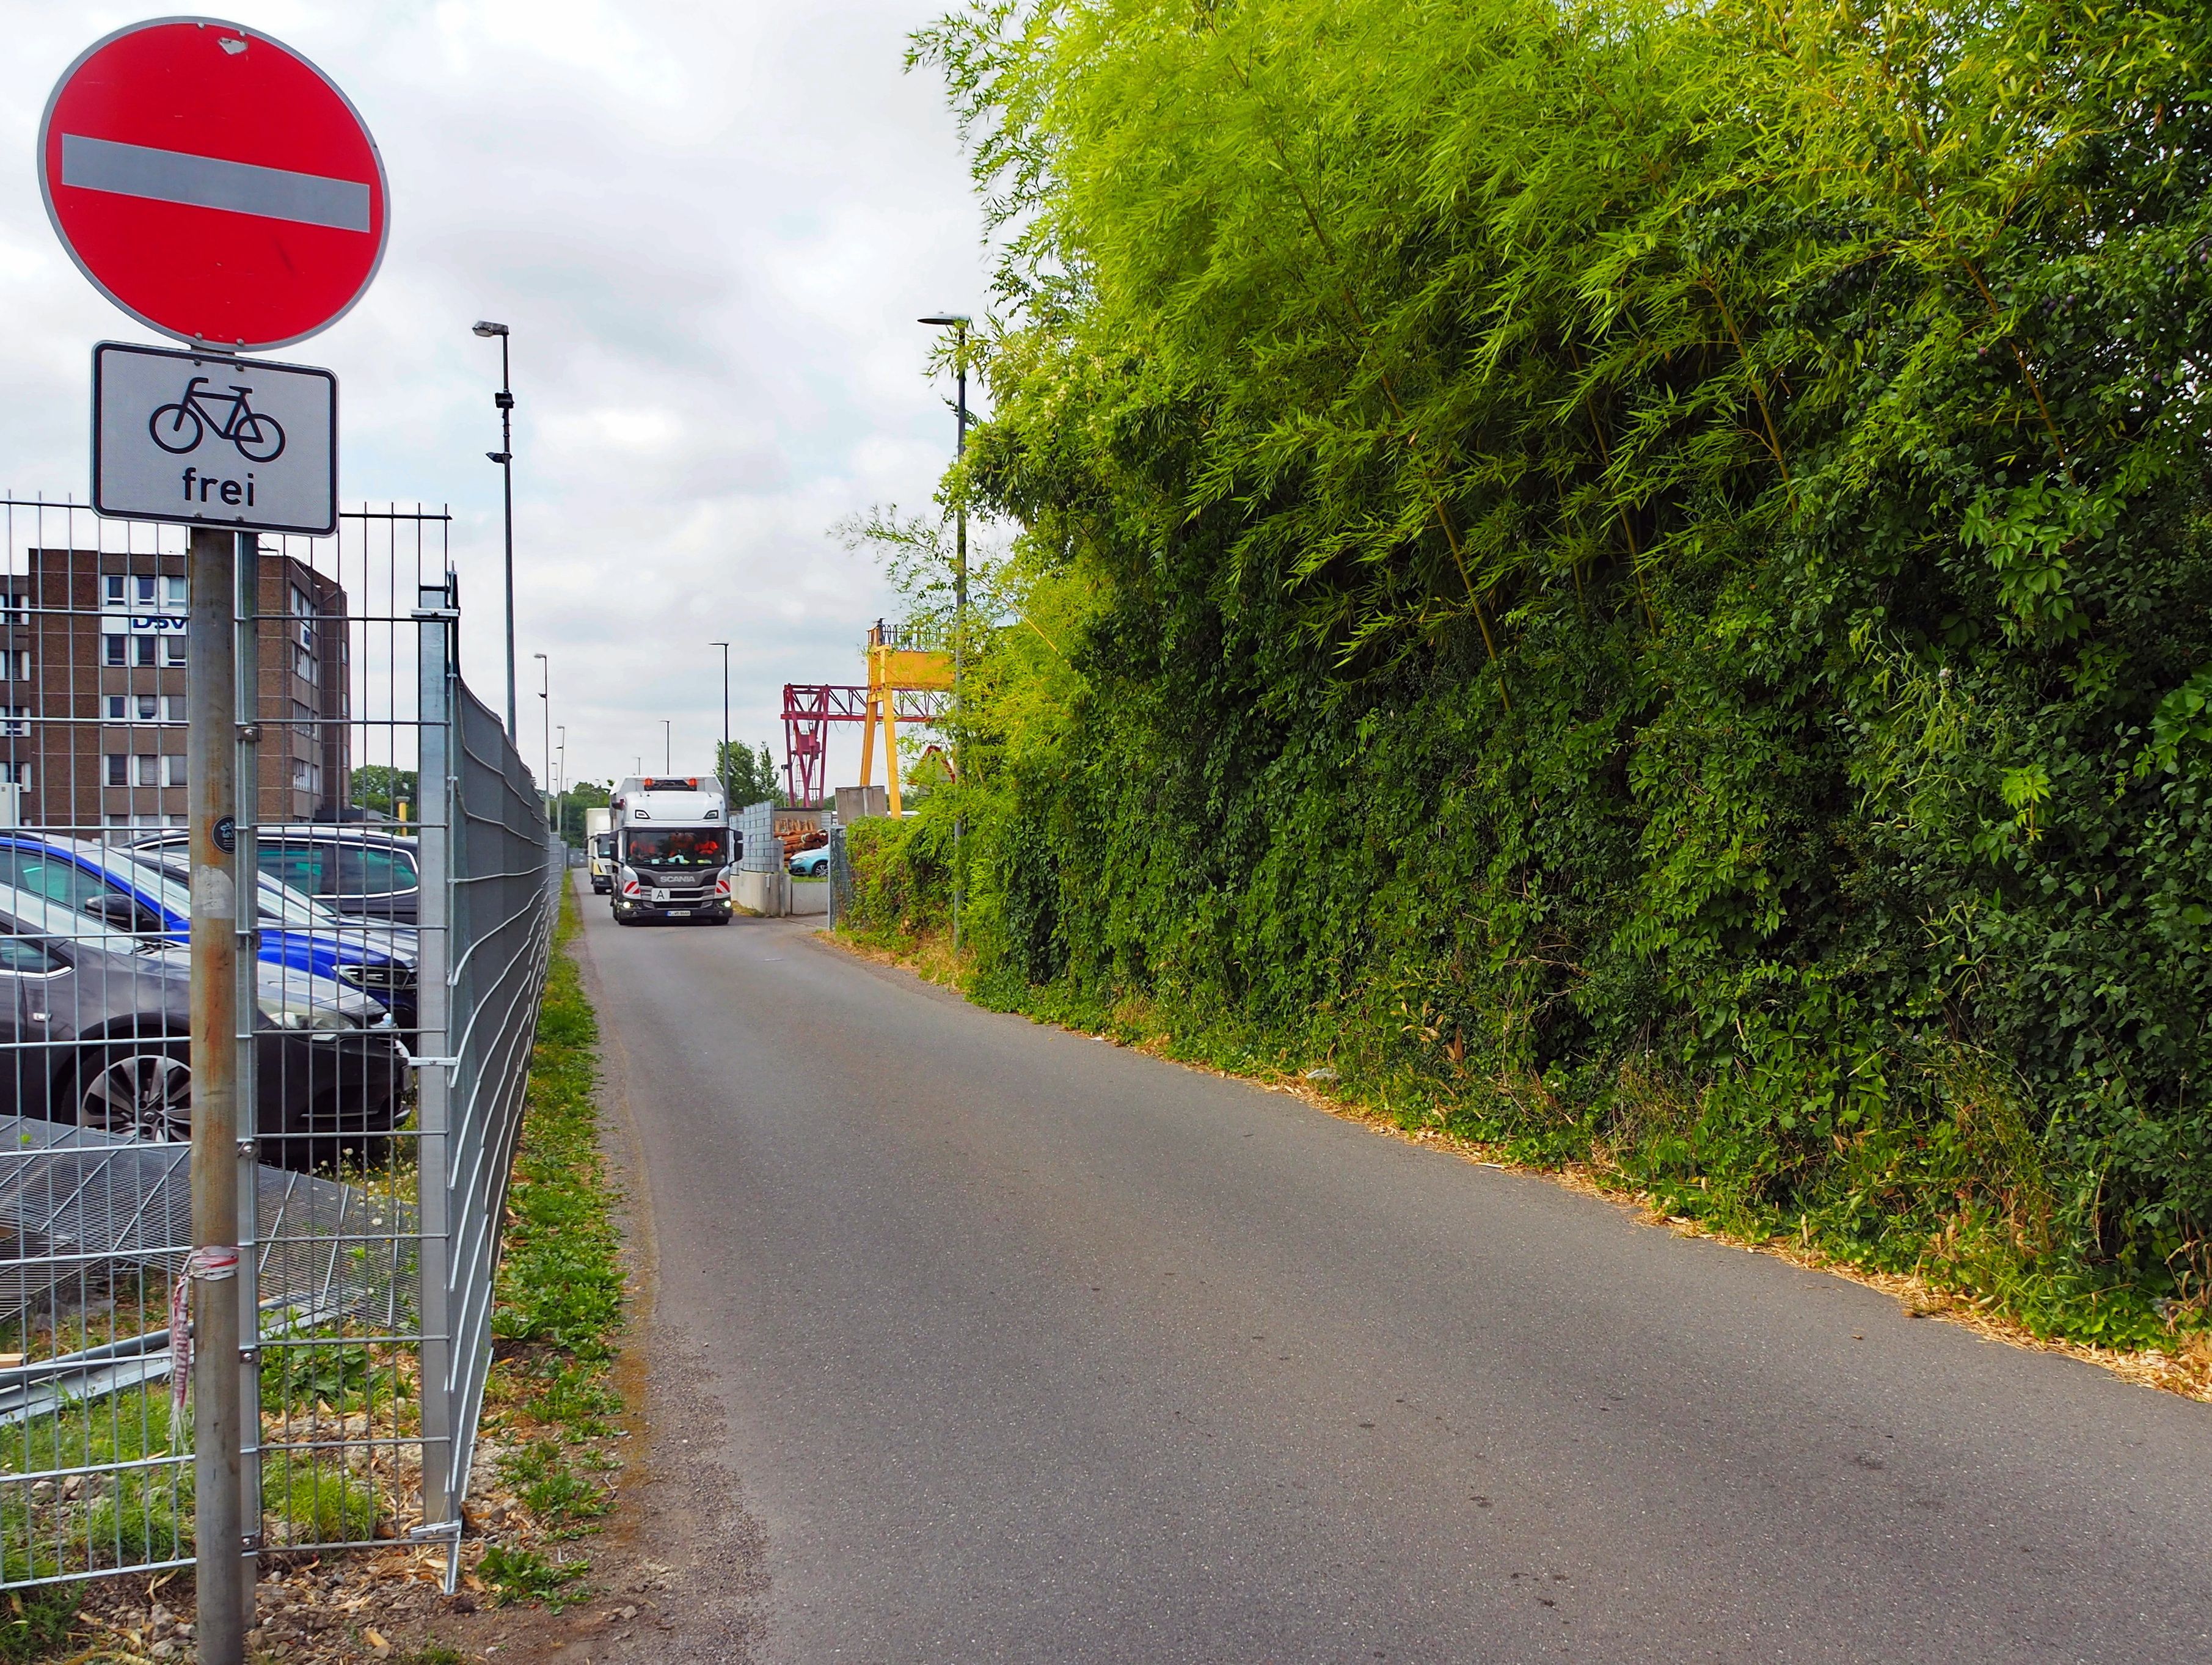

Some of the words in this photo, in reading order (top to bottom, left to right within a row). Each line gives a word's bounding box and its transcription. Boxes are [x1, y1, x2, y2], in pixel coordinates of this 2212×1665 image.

[182, 467, 254, 507] frei
[133, 613, 187, 629] DSV
[656, 890, 665, 899] A
